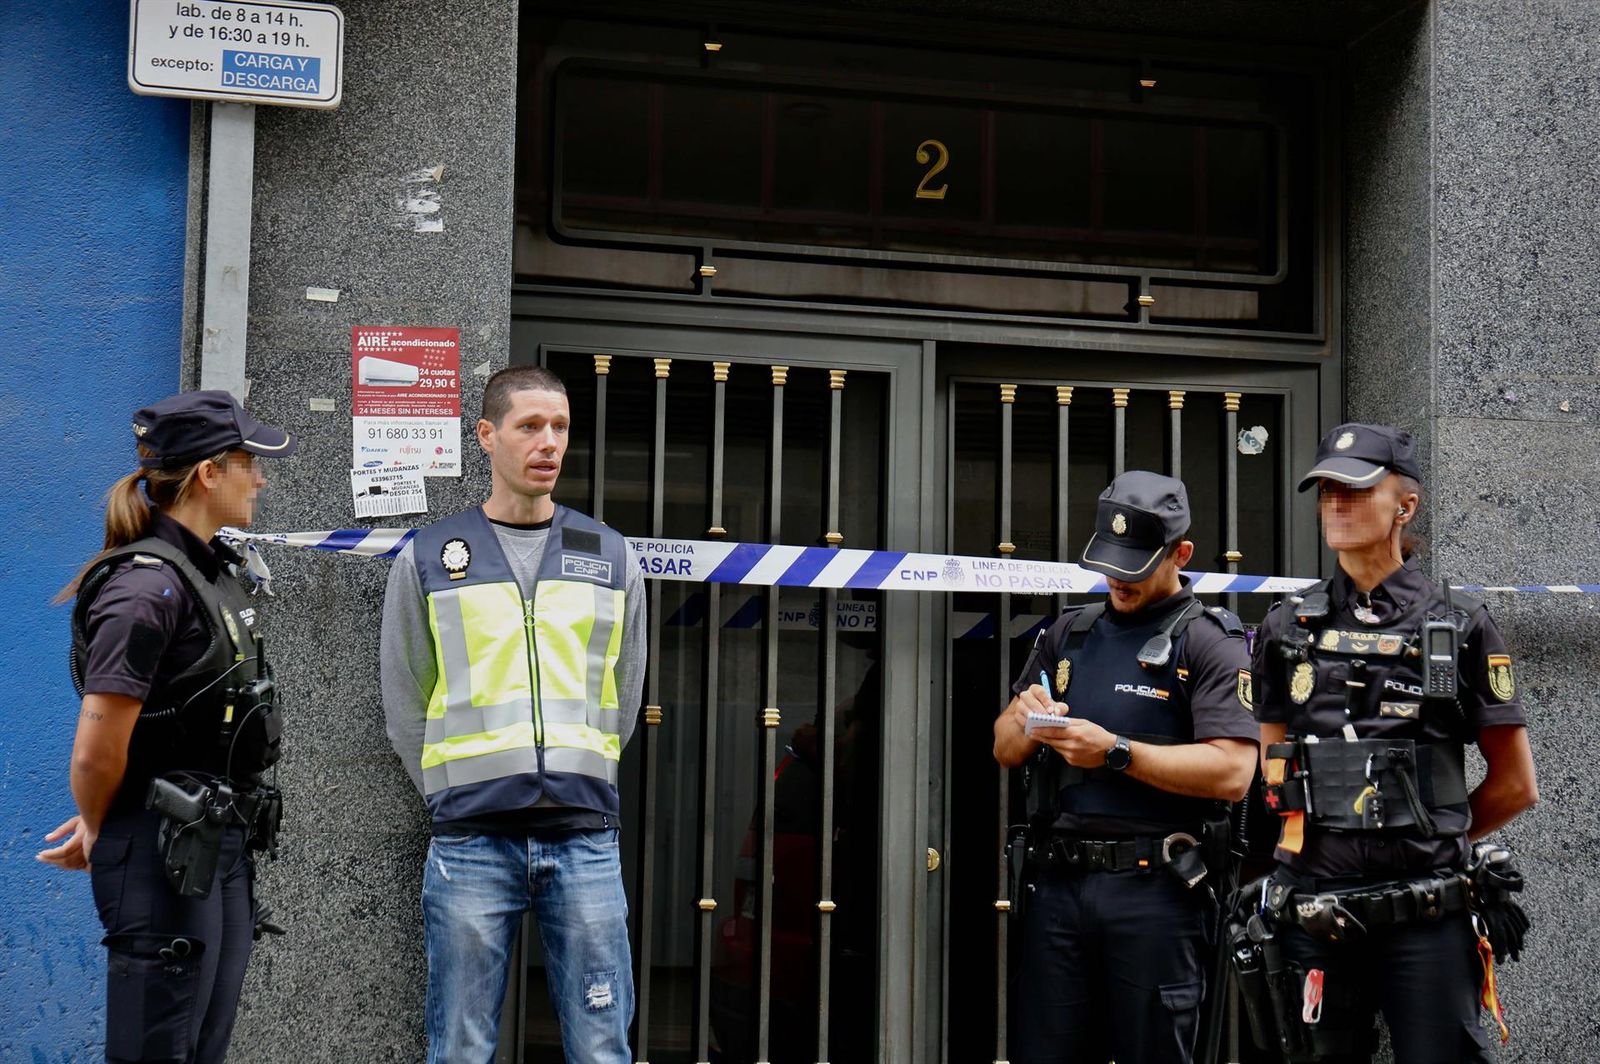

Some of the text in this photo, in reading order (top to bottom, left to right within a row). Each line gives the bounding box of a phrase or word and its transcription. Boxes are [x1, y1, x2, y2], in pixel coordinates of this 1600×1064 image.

[176, 2, 303, 27] lab. de 8 a 14 h.
[169, 24, 310, 48] y de 16:30 a 19 h.
[151, 57, 214, 72] excepto:
[234, 53, 308, 72] CARGA Y
[223, 72, 318, 92] DESCARGA
[916, 139, 949, 199] 2
[357, 336, 389, 347] AIRE
[419, 378, 456, 389] 29,90 €
[412, 408, 454, 416] INTERESES
[368, 428, 443, 439] 91 680 33 91
[383, 465, 420, 473] MUDANZAS
[647, 542, 694, 554] POLICIA
[565, 558, 608, 572] POLICIA
[574, 566, 599, 574] CNP
[639, 556, 692, 576] ASAR
[972, 560, 1071, 574] LINEA DE POLICIA
[900, 569, 938, 581] CNP
[975, 573, 1073, 590] NO PASAR
[836, 602, 866, 613] LINEA
[1114, 684, 1157, 695] POLICIA
[1384, 679, 1424, 696] POLICI
